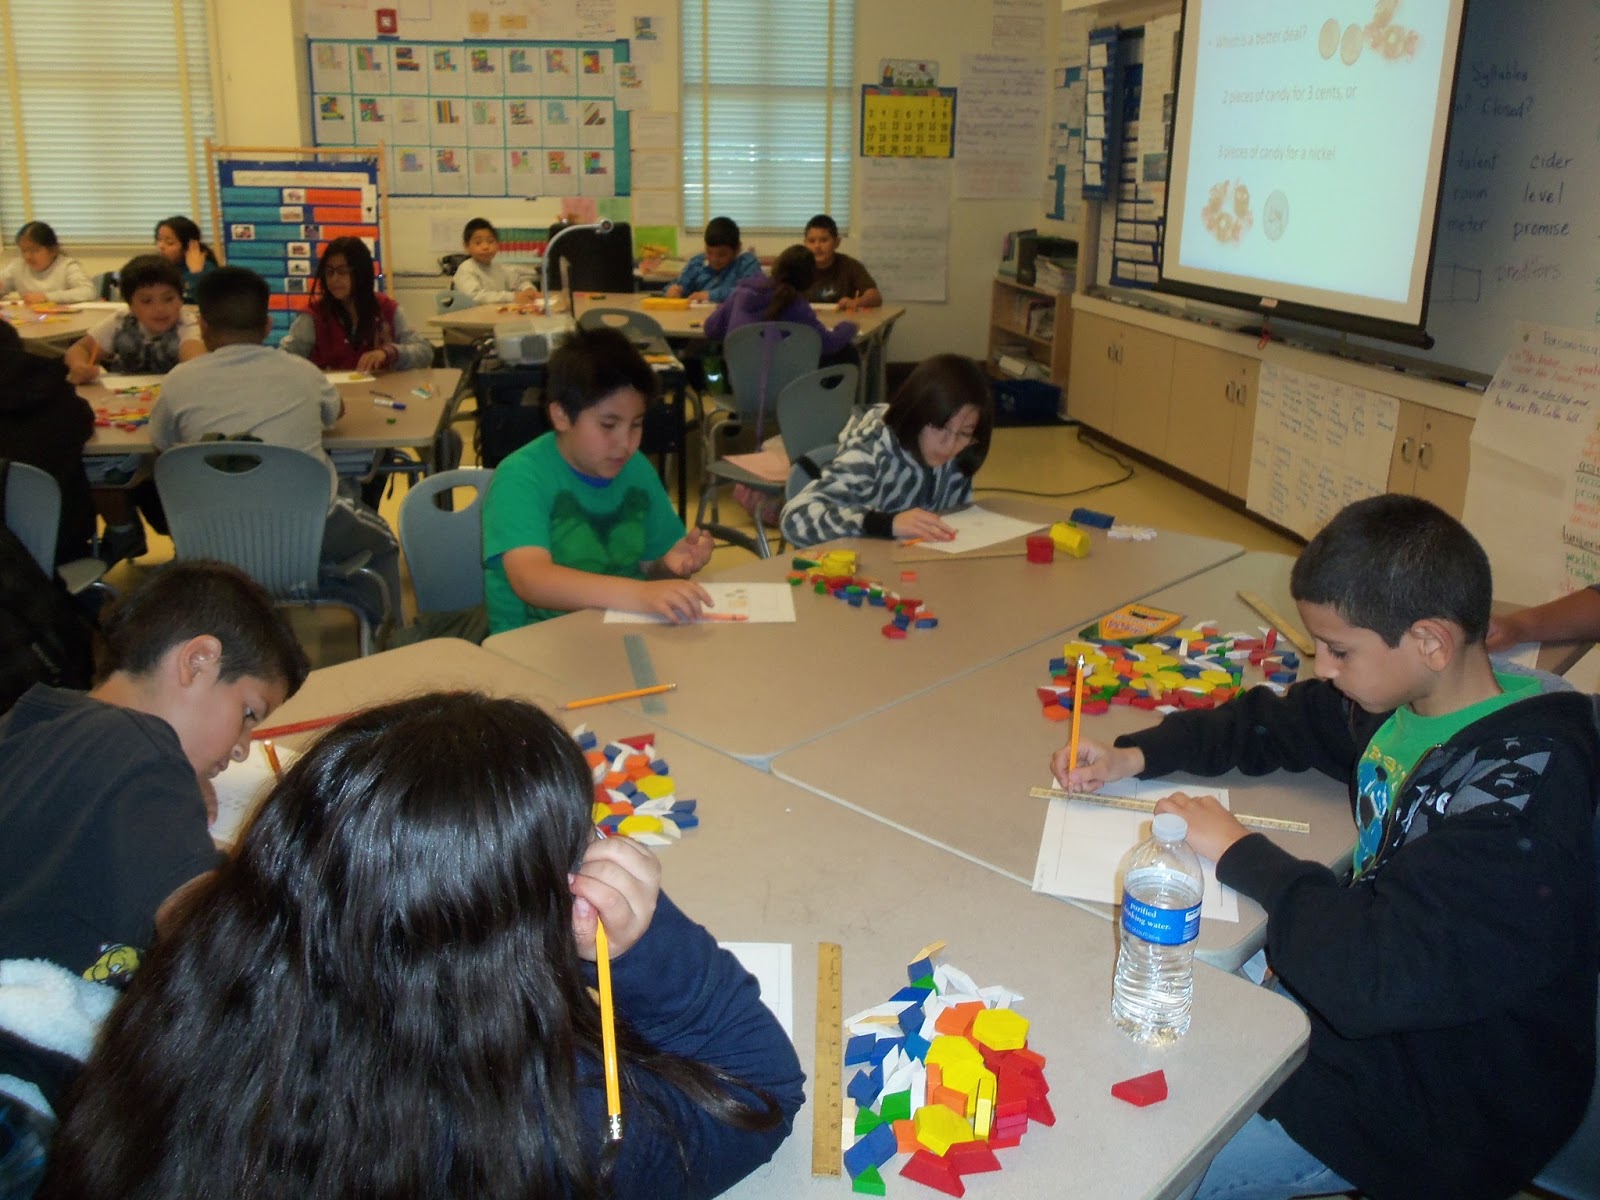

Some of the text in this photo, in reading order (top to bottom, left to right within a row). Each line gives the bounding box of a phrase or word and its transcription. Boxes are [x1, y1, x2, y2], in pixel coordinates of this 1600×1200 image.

[1255, 31, 1281, 45] better
[1282, 24, 1308, 42] deal?
[1229, 89, 1254, 105] pieces
[1254, 88, 1265, 102] of
[1265, 87, 1291, 104] candy
[1292, 85, 1306, 101] for
[1307, 84, 1314, 100] 3
[1315, 85, 1344, 101] cents,
[1345, 85, 1358, 98] or
[1249, 144, 1259, 159] of
[1259, 145, 1285, 161] candy
[1286, 144, 1299, 159] for
[1300, 148, 1307, 160] a
[1308, 144, 1336, 161] nickel
[1529, 154, 1573, 170] cider
[1523, 182, 1564, 204] level
[1512, 221, 1570, 241] promise
[1130, 902, 1158, 919] purified
